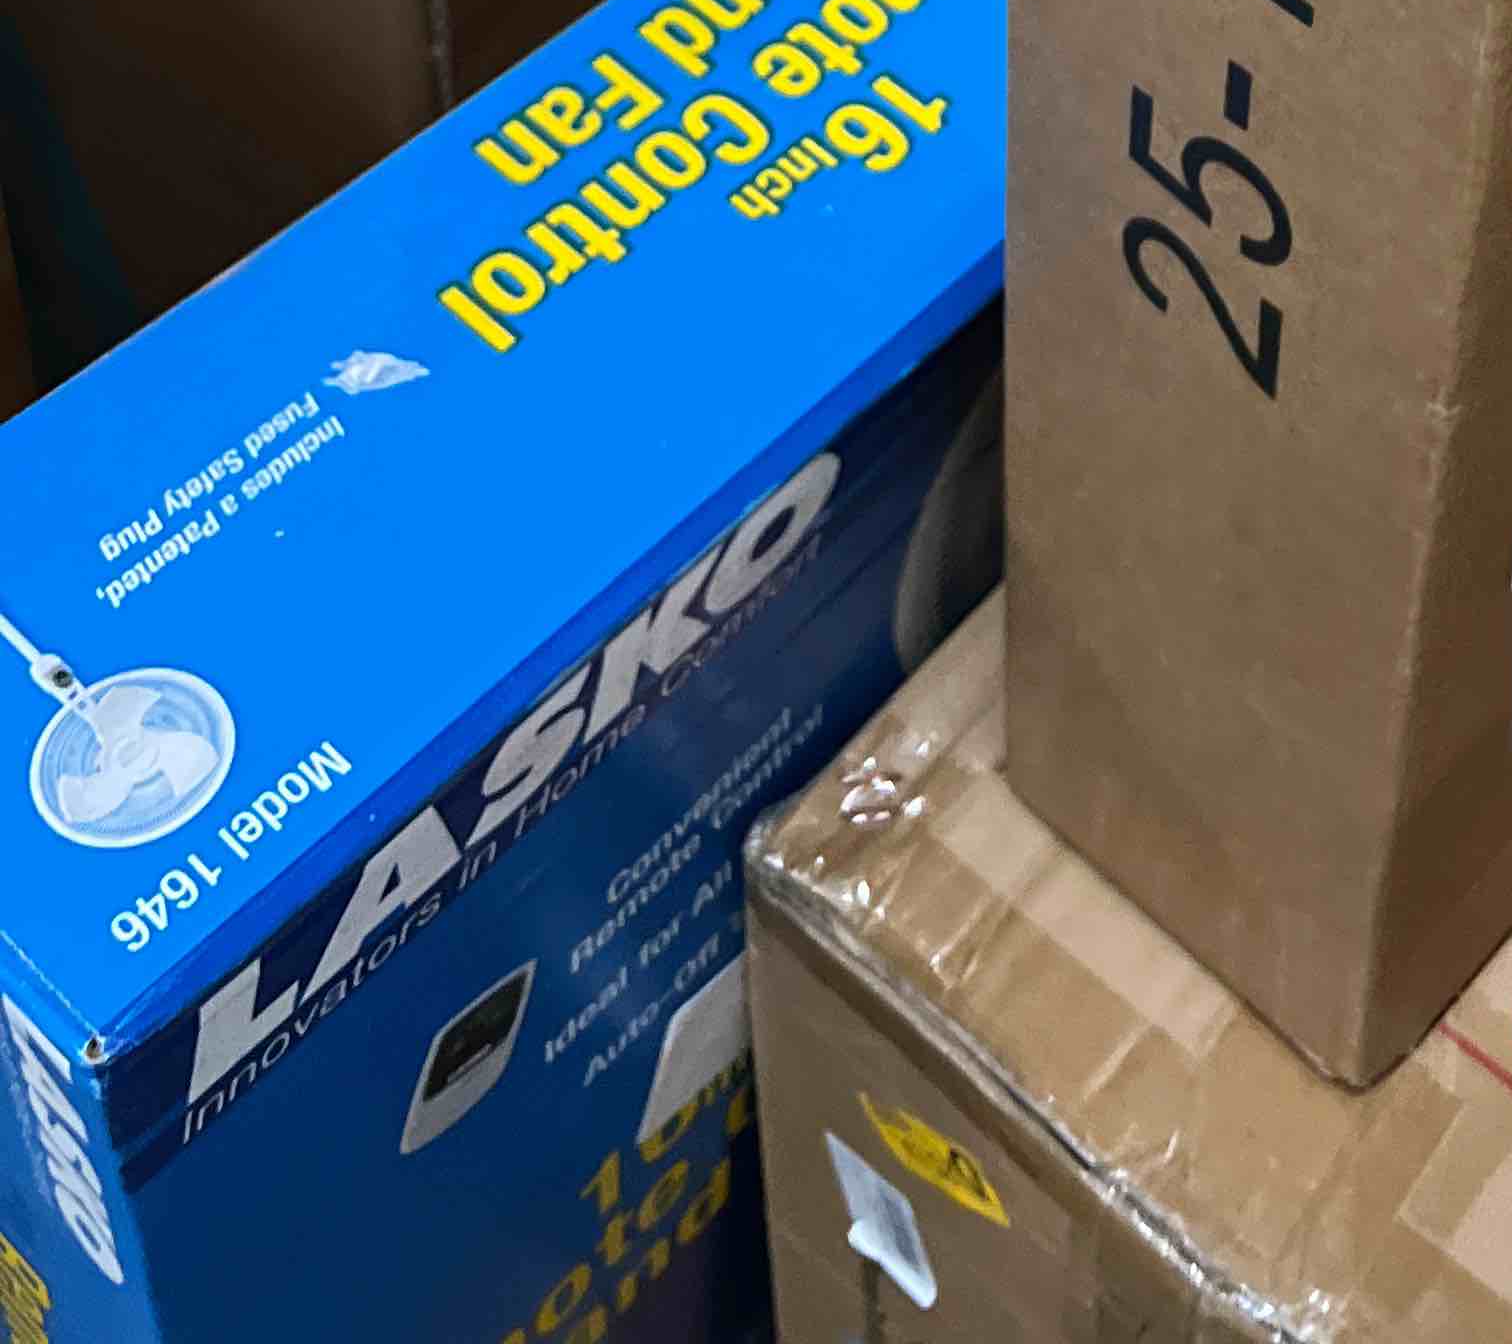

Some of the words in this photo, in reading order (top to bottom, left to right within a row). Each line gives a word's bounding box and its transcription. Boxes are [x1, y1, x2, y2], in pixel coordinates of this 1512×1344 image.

[474, 52, 666, 185] Fan
[824, 75, 948, 172] 16
[437, 92, 772, 352] Control
[728, 136, 839, 220] Inch
[240, 415, 346, 501] Includes
[243, 390, 321, 460] Fused
[99, 507, 164, 562] Plug
[161, 447, 245, 518] Safety
[218, 493, 239, 517] a
[95, 508, 221, 609] Patented,
[187, 452, 842, 1108] LASKO
[217, 740, 353, 861] Model
[607, 706, 792, 905] Convenient
[569, 833, 702, 976] Remote
[710, 703, 824, 831] Control
[109, 853, 223, 954] 1646
[181, 893, 443, 1145] Innovators
[455, 838, 499, 893] in
[512, 703, 648, 840] Home
[543, 963, 629, 1065] Ideal
[637, 912, 683, 969] for
[691, 858, 735, 918] All
[1, 991, 126, 1286] LASKO
